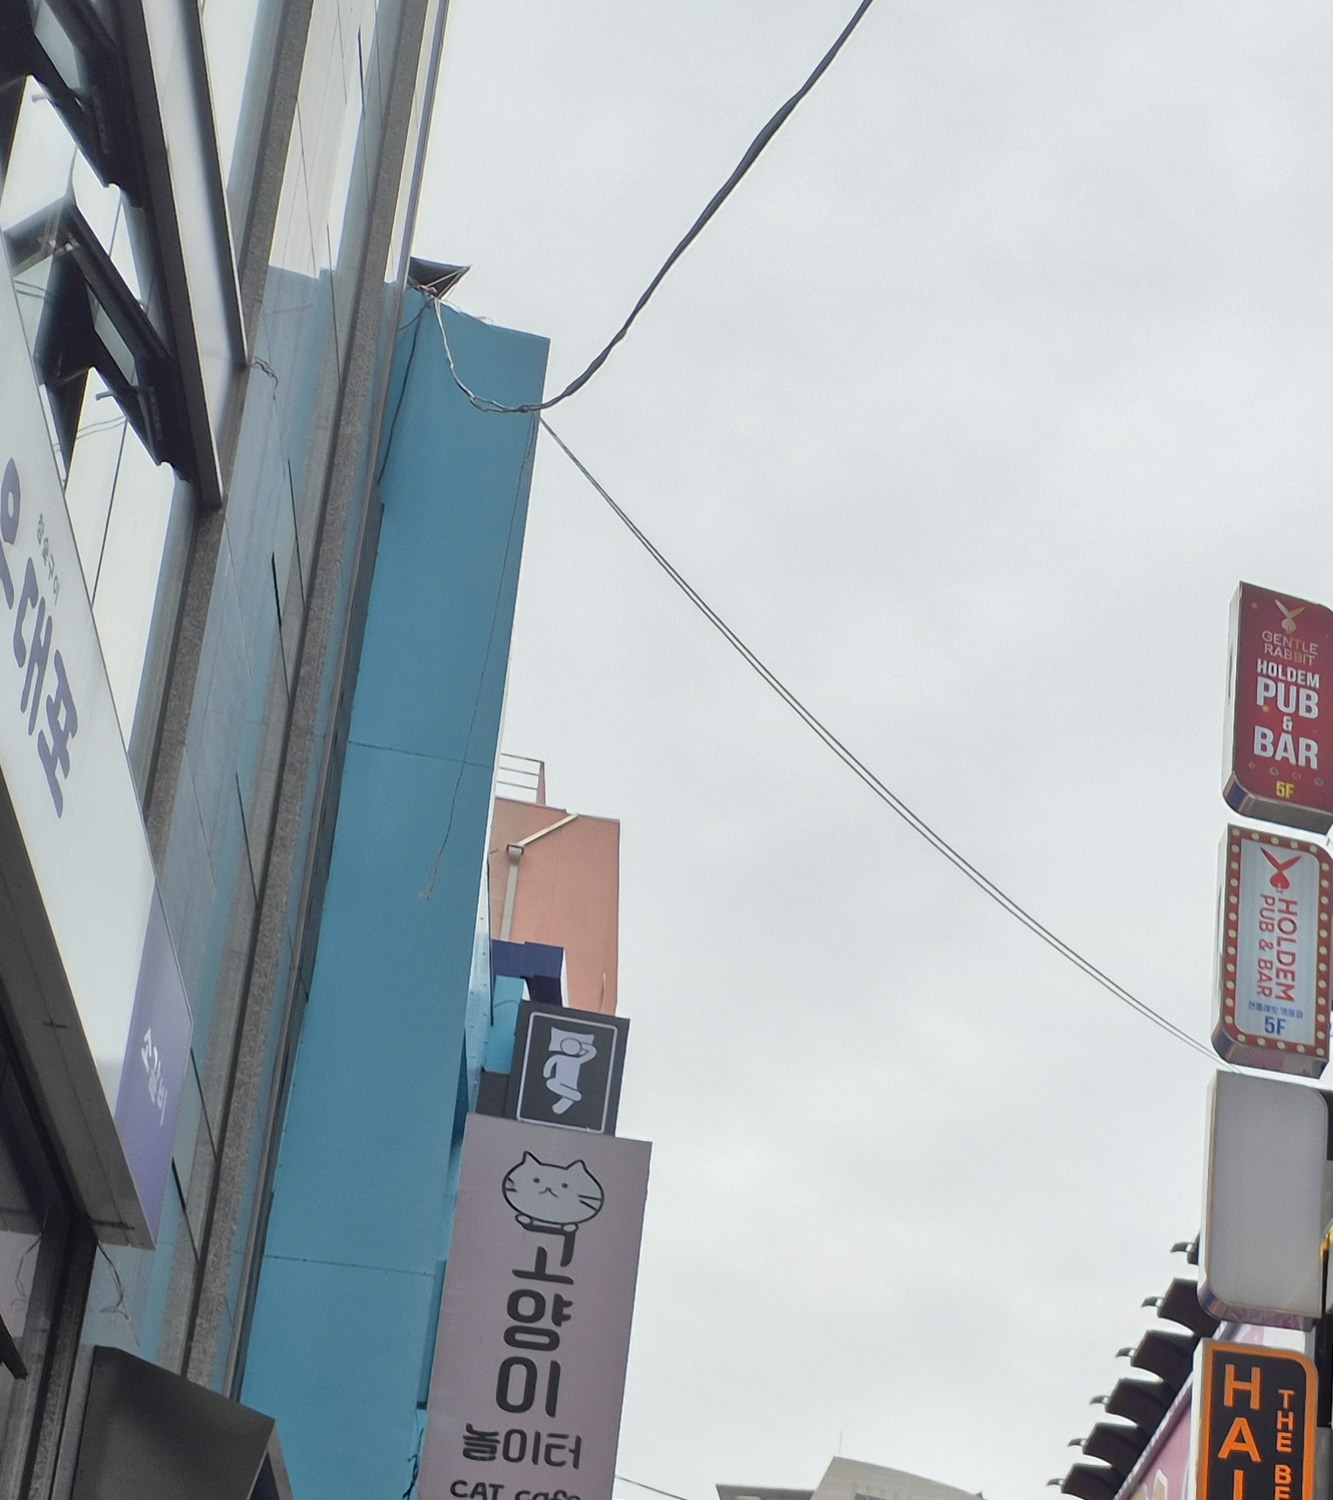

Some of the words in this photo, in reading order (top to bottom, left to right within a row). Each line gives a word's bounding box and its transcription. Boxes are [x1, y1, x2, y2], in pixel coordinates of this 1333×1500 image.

[1261, 630, 1319, 656] GENTLE
[1264, 643, 1316, 667] RABBIT
[1256, 658, 1320, 689] HOLDEM
[1256, 675, 1319, 720] PUB
[1282, 716, 1293, 732] &
[1253, 725, 1319, 770] BAR
[1276, 780, 1295, 799] 5F
[1258, 893, 1276, 934] PUB
[1258, 938, 1275, 952] &
[1275, 897, 1298, 1003] HOLDEM
[1256, 957, 1274, 999] BAR
[1264, 1015, 1287, 1036] 5F
[495, 1222, 575, 1418] 고양이
[1276, 1389, 1295, 1453] THE
[462, 1422, 582, 1470] 놀이터
